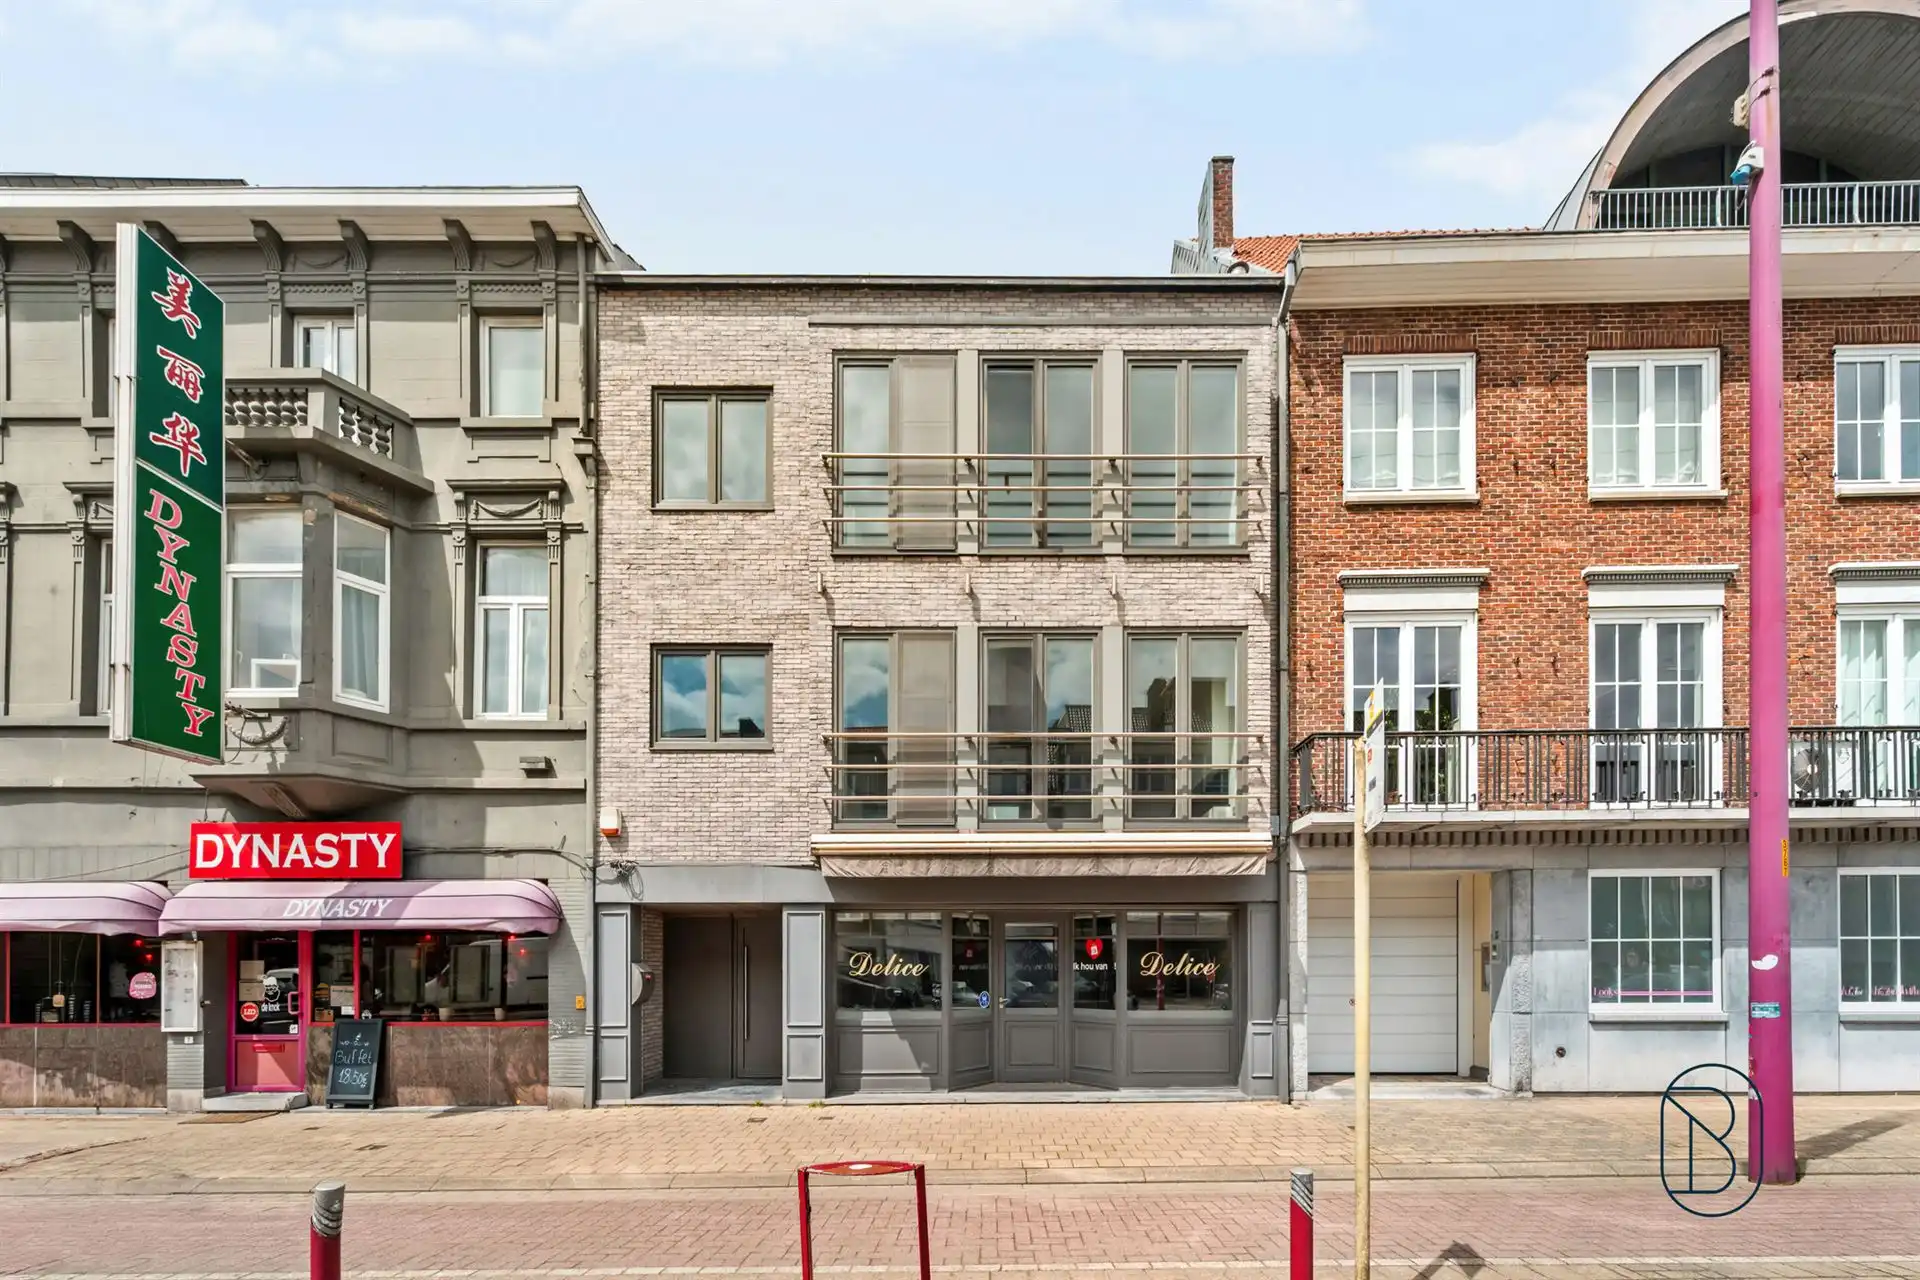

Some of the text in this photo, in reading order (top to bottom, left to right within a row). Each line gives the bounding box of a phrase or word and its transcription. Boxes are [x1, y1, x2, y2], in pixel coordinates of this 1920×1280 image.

[150, 266, 207, 477] 美丽华
[144, 488, 215, 737] DYNASTY
[195, 832, 397, 868] DYNASTY
[282, 898, 392, 918] DYNASTY
[848, 951, 930, 977] Delice
[1080, 961, 1094, 971] hou
[1095, 963, 1108, 971] van
[1140, 951, 1221, 976] Delice
[335, 1049, 372, 1065] Buffet
